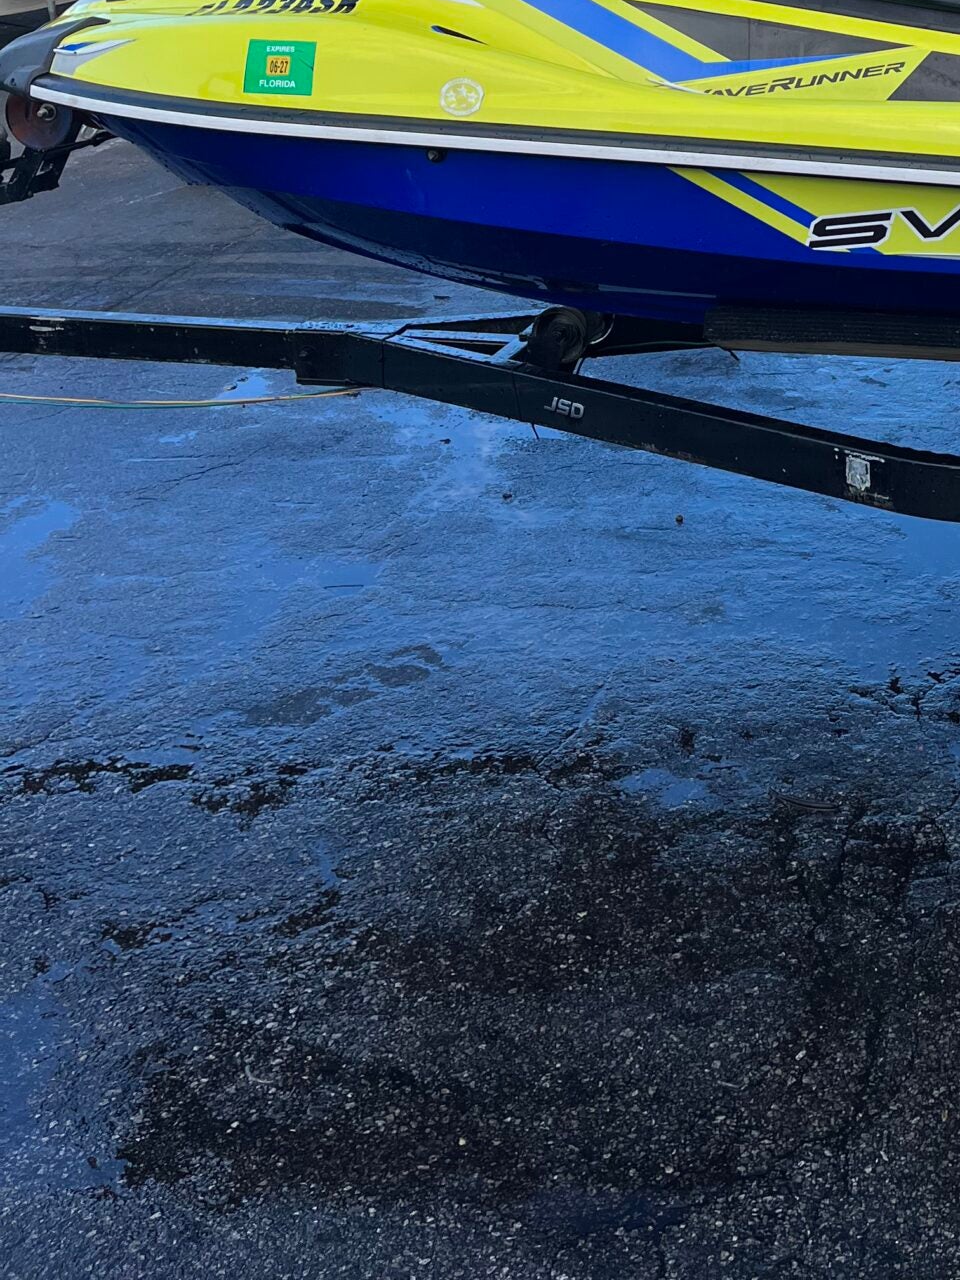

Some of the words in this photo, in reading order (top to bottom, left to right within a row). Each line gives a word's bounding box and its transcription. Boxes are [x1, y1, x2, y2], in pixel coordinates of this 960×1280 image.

[266, 45, 295, 53] EXPIRES
[269, 60, 289, 74] 06-27
[258, 79, 296, 88] FLORIDA
[704, 61, 906, 97] AVERUNNER
[543, 396, 585, 419] JSD
